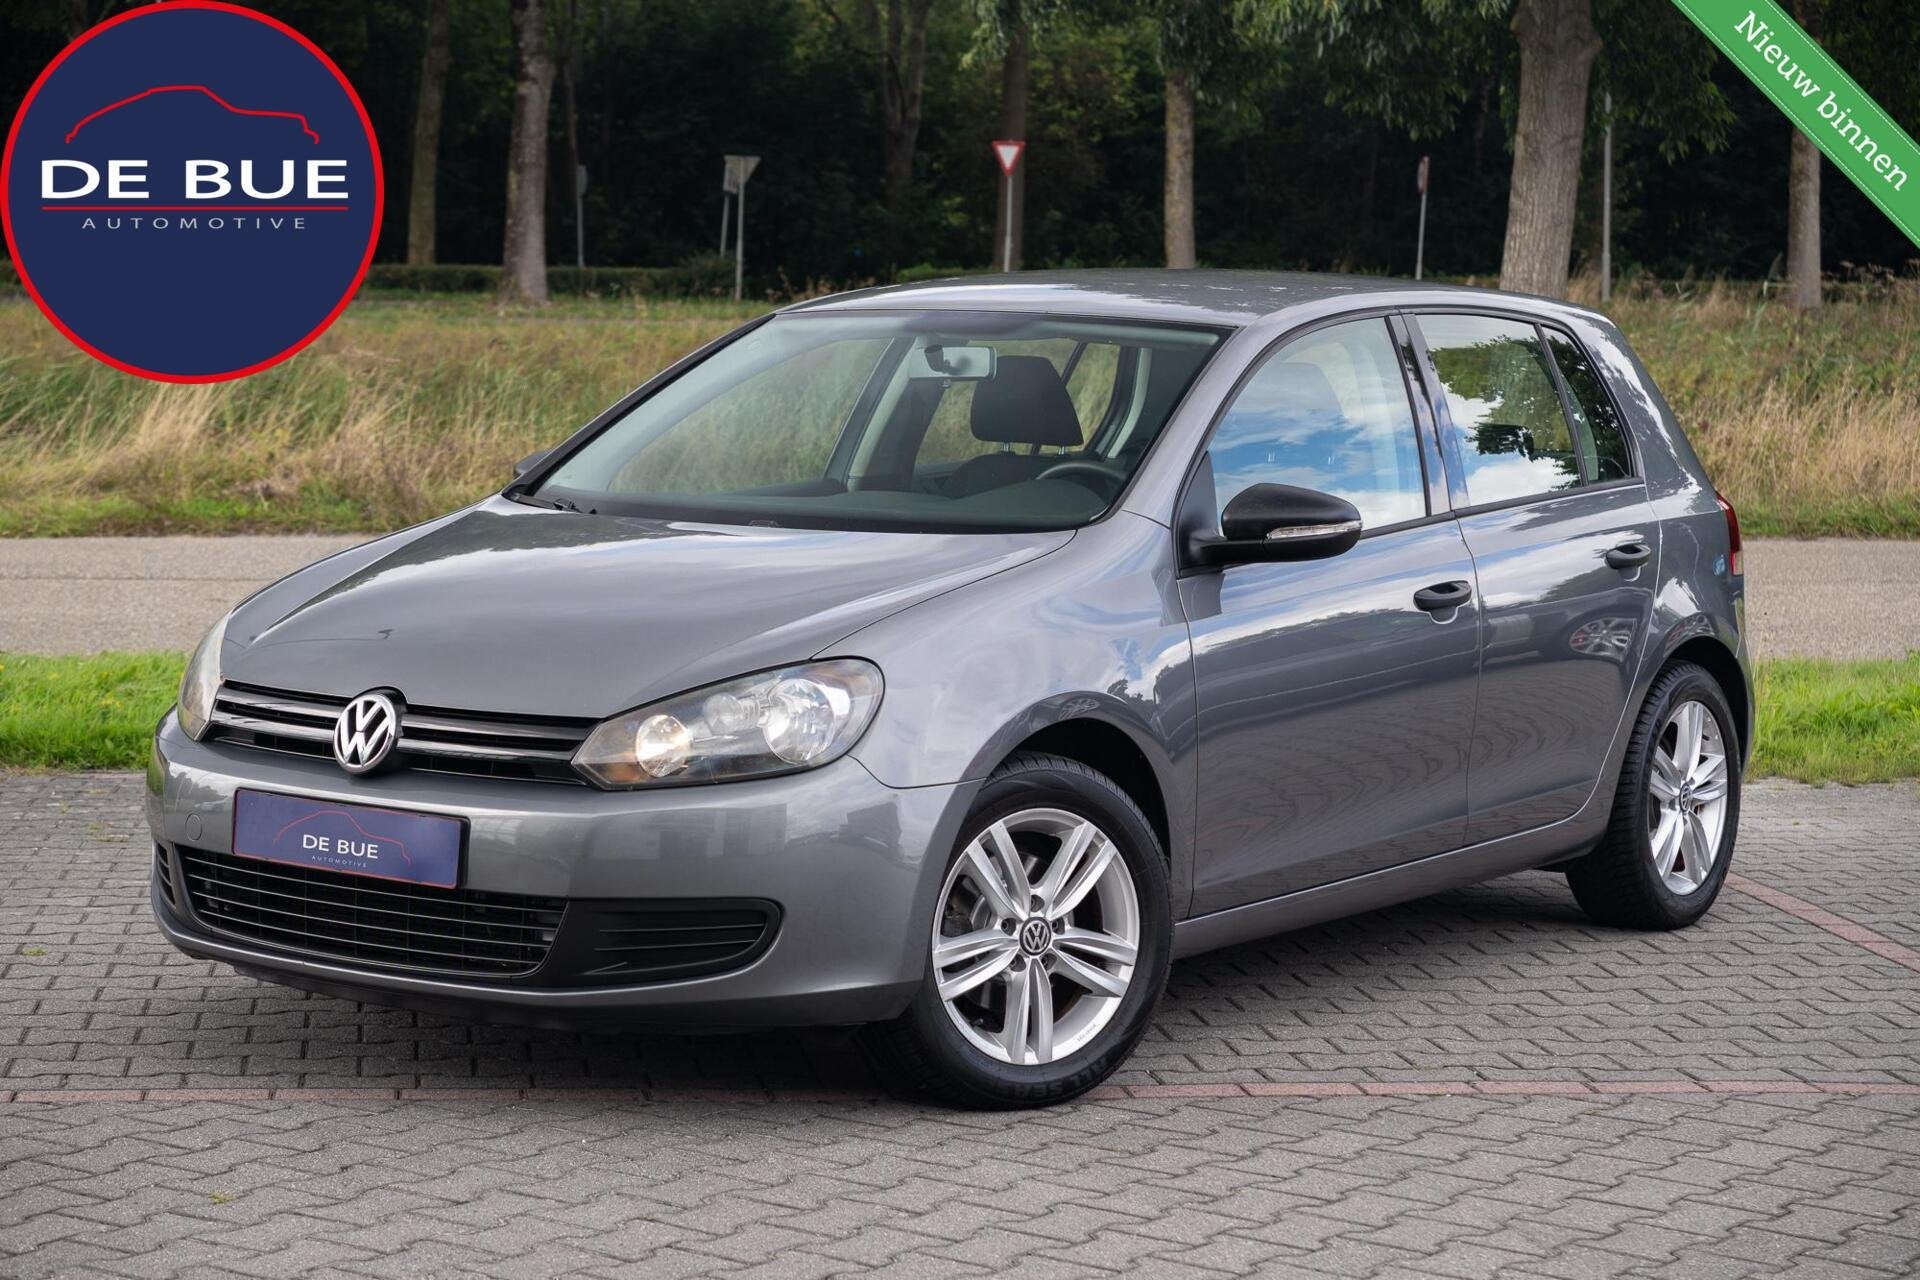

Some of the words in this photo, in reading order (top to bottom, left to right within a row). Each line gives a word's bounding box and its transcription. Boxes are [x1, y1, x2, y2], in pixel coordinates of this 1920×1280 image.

[302, 834, 330, 852] DE
[337, 839, 379, 859] BUE
[311, 855, 367, 868] AUTOMOTIVE
